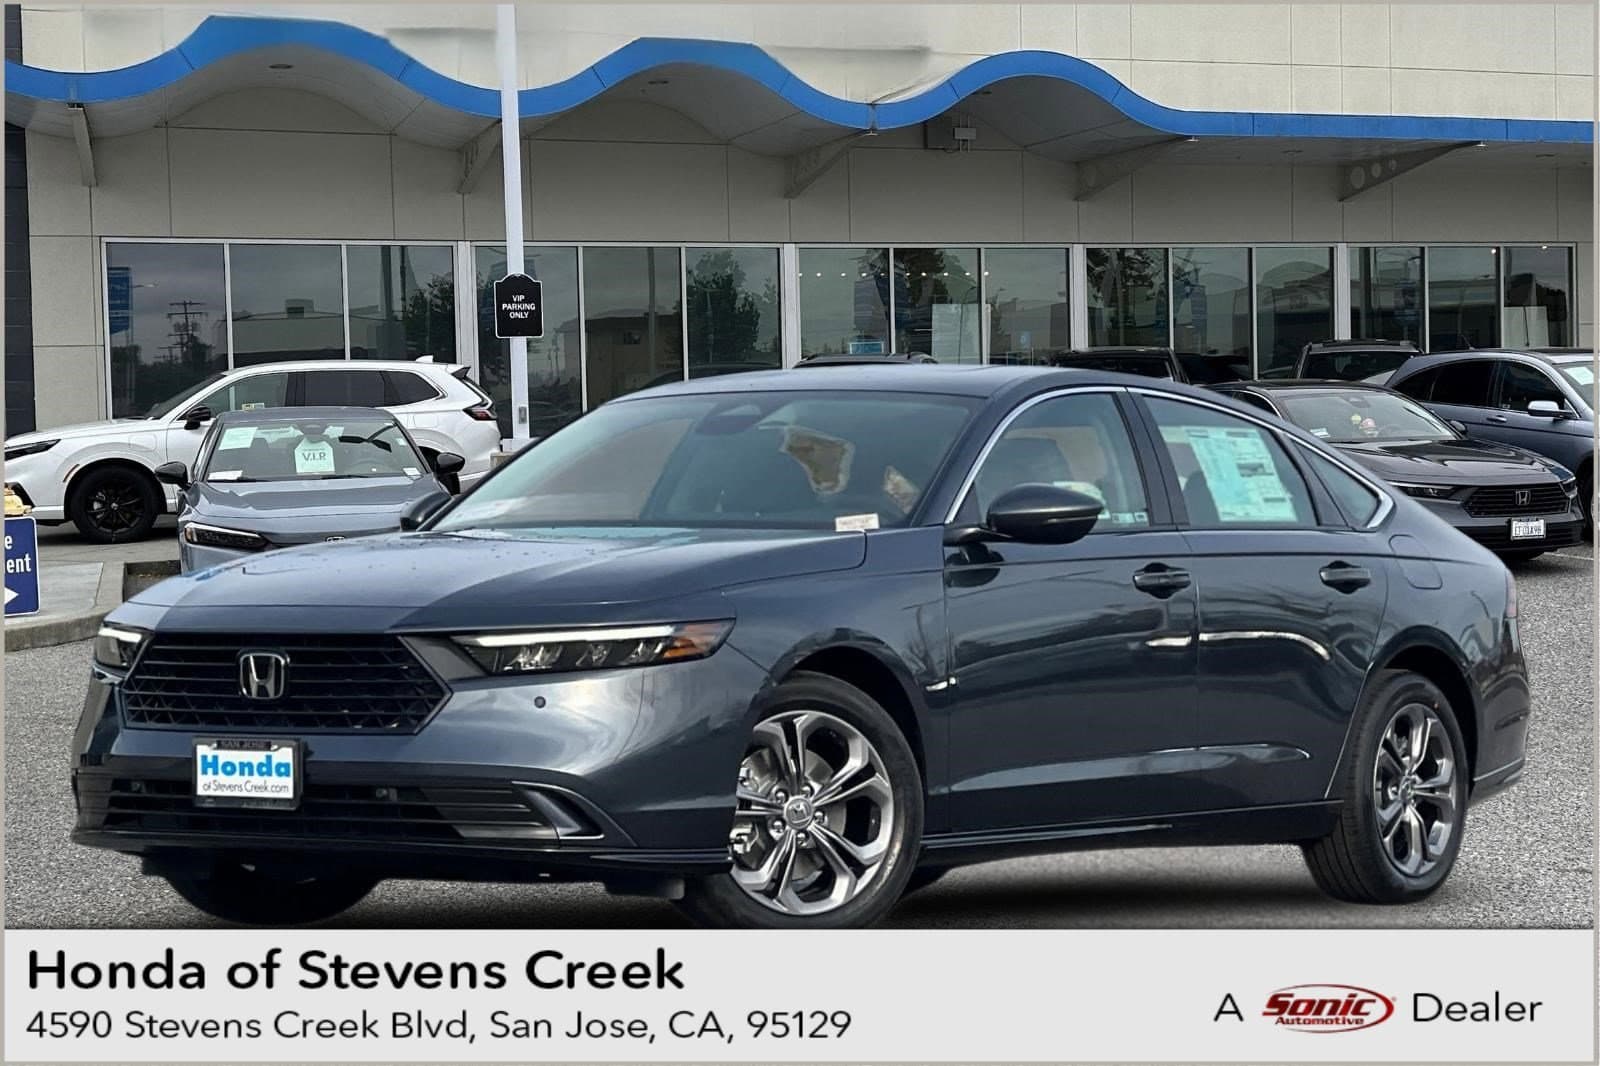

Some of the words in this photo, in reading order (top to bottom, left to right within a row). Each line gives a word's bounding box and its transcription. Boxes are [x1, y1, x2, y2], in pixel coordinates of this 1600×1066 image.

[502, 303, 536, 311] PARKING
[509, 311, 529, 319] ONLY
[200, 754, 291, 778] Honda
